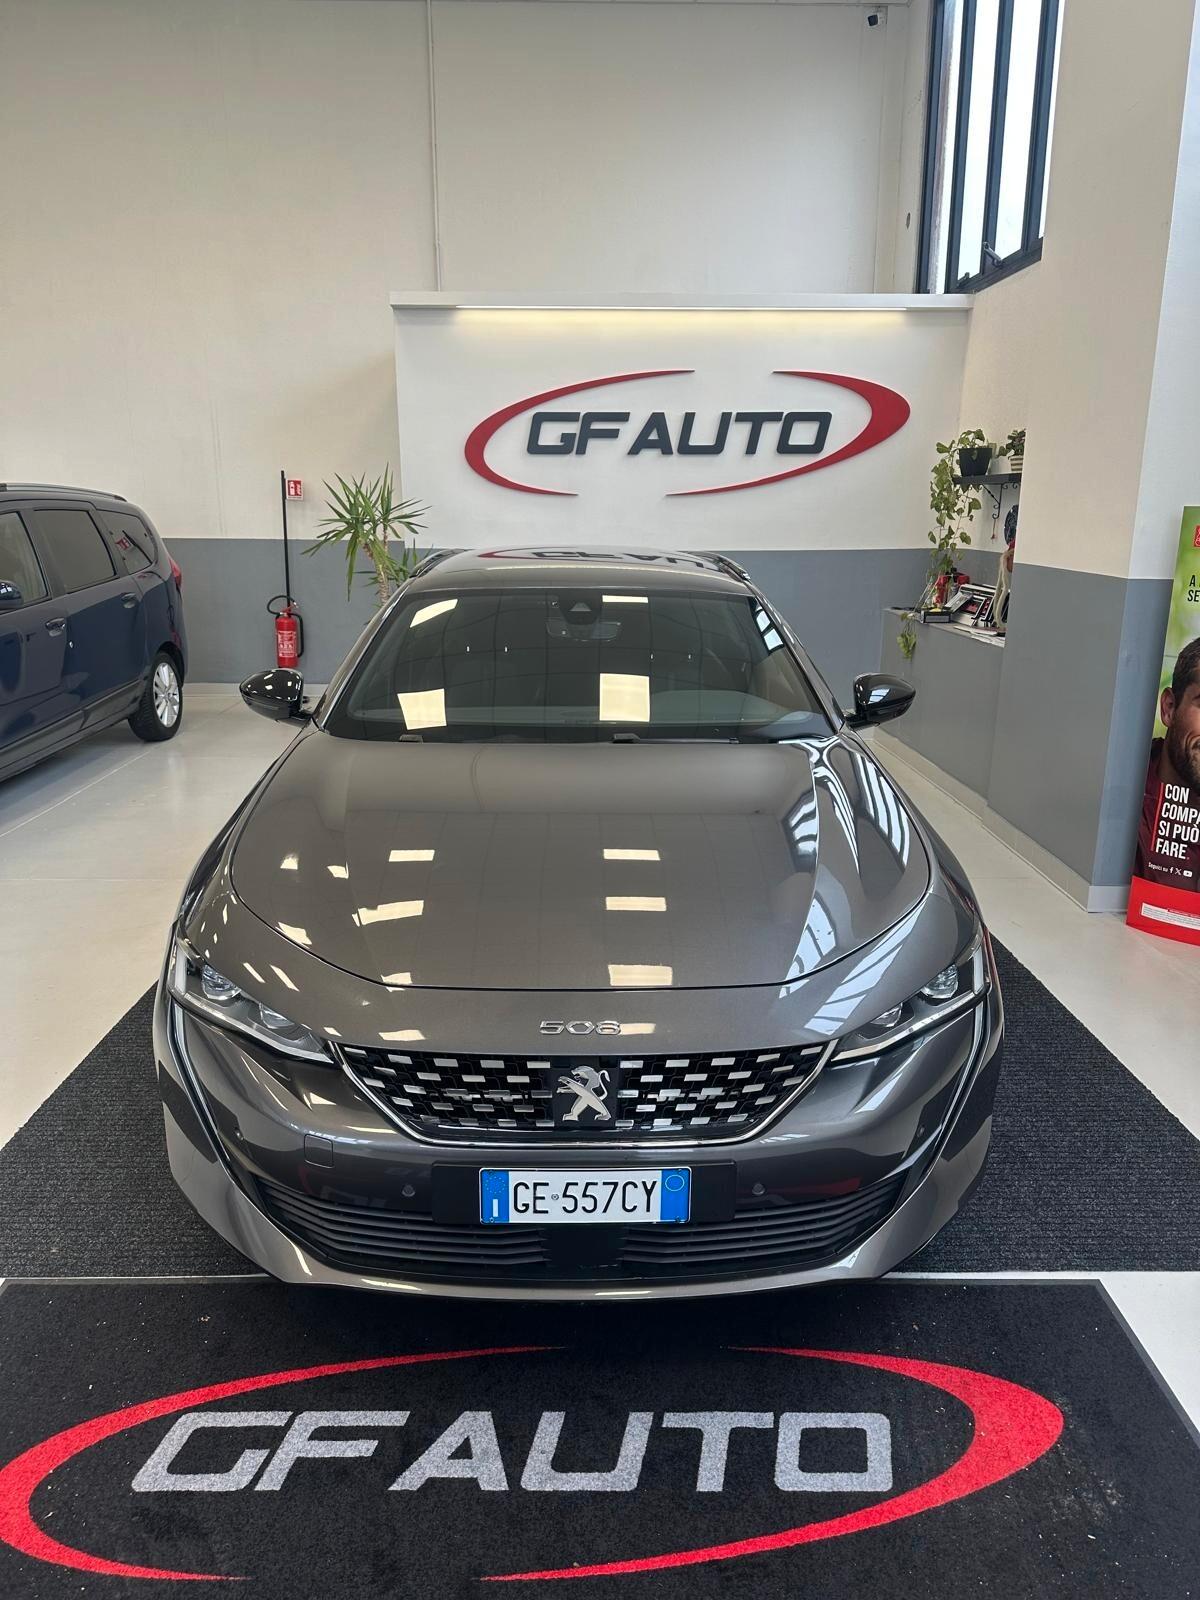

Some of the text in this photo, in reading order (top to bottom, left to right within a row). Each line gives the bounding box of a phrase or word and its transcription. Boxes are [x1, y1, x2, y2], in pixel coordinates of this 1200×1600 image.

[1164, 783, 1190, 804] CON
[1158, 820, 1200, 843] SI PUÒ
[539, 1020, 621, 1035] 508
